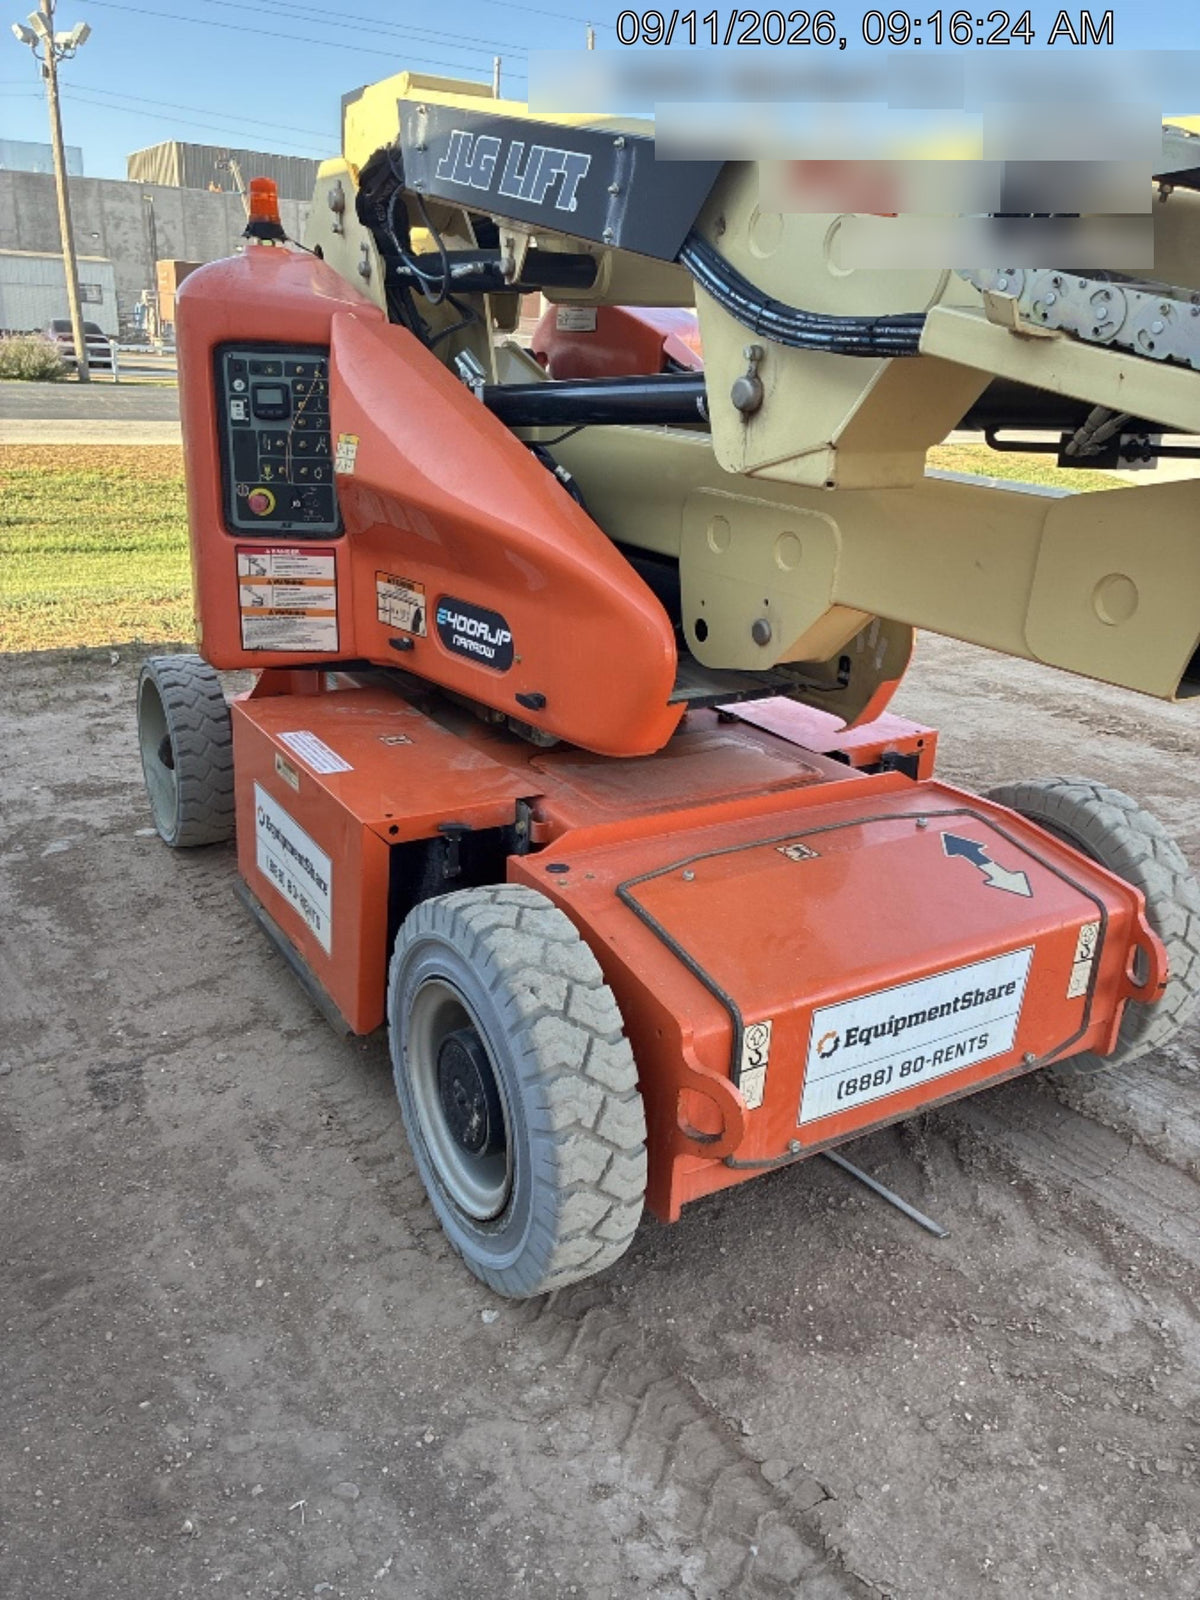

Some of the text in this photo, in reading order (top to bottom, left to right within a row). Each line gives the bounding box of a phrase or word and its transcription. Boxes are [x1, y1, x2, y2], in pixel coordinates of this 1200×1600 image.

[435, 129, 592, 212] JLG LIFT
[452, 634, 495, 659] NARROW
[843, 980, 1016, 1047] EquipmentShare
[836, 1032, 989, 1099] (888) 80-RENTS
